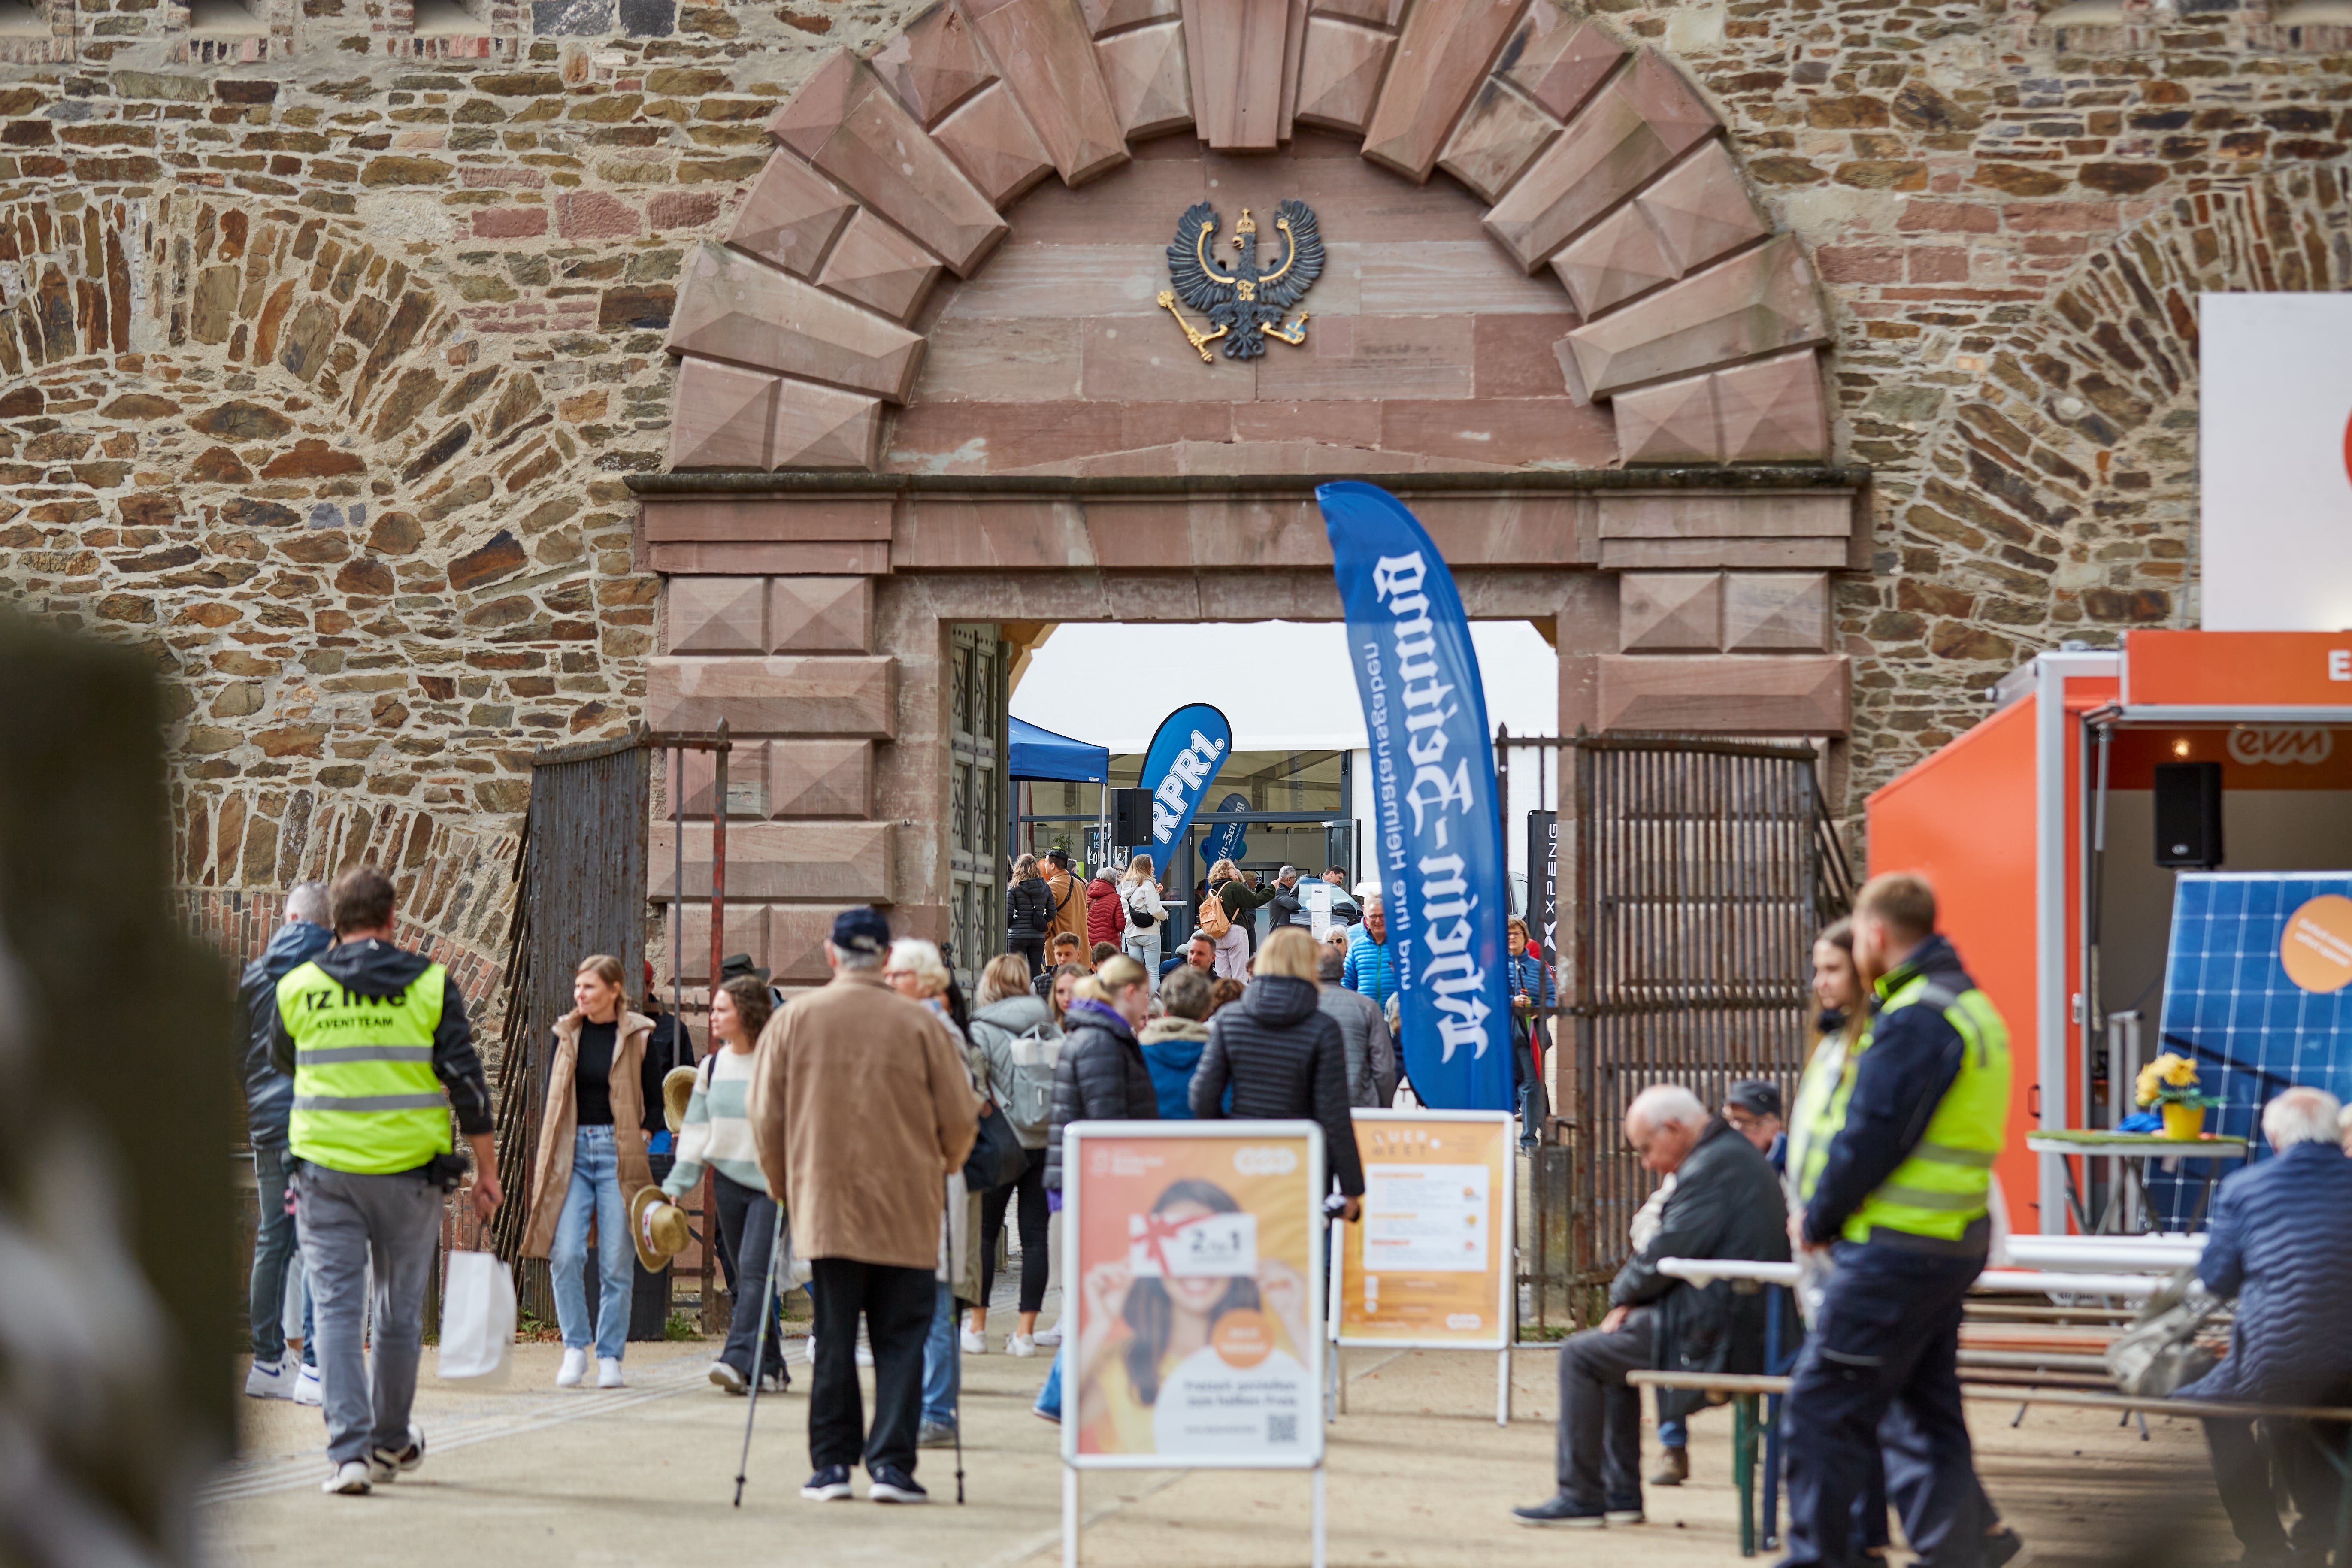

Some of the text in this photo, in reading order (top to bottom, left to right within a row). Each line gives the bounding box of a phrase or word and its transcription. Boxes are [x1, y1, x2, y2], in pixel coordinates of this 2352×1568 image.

[1152, 729, 1225, 844] RPR1.
[1546, 823, 1558, 914] XPENG
[307, 990, 332, 1011] rz
